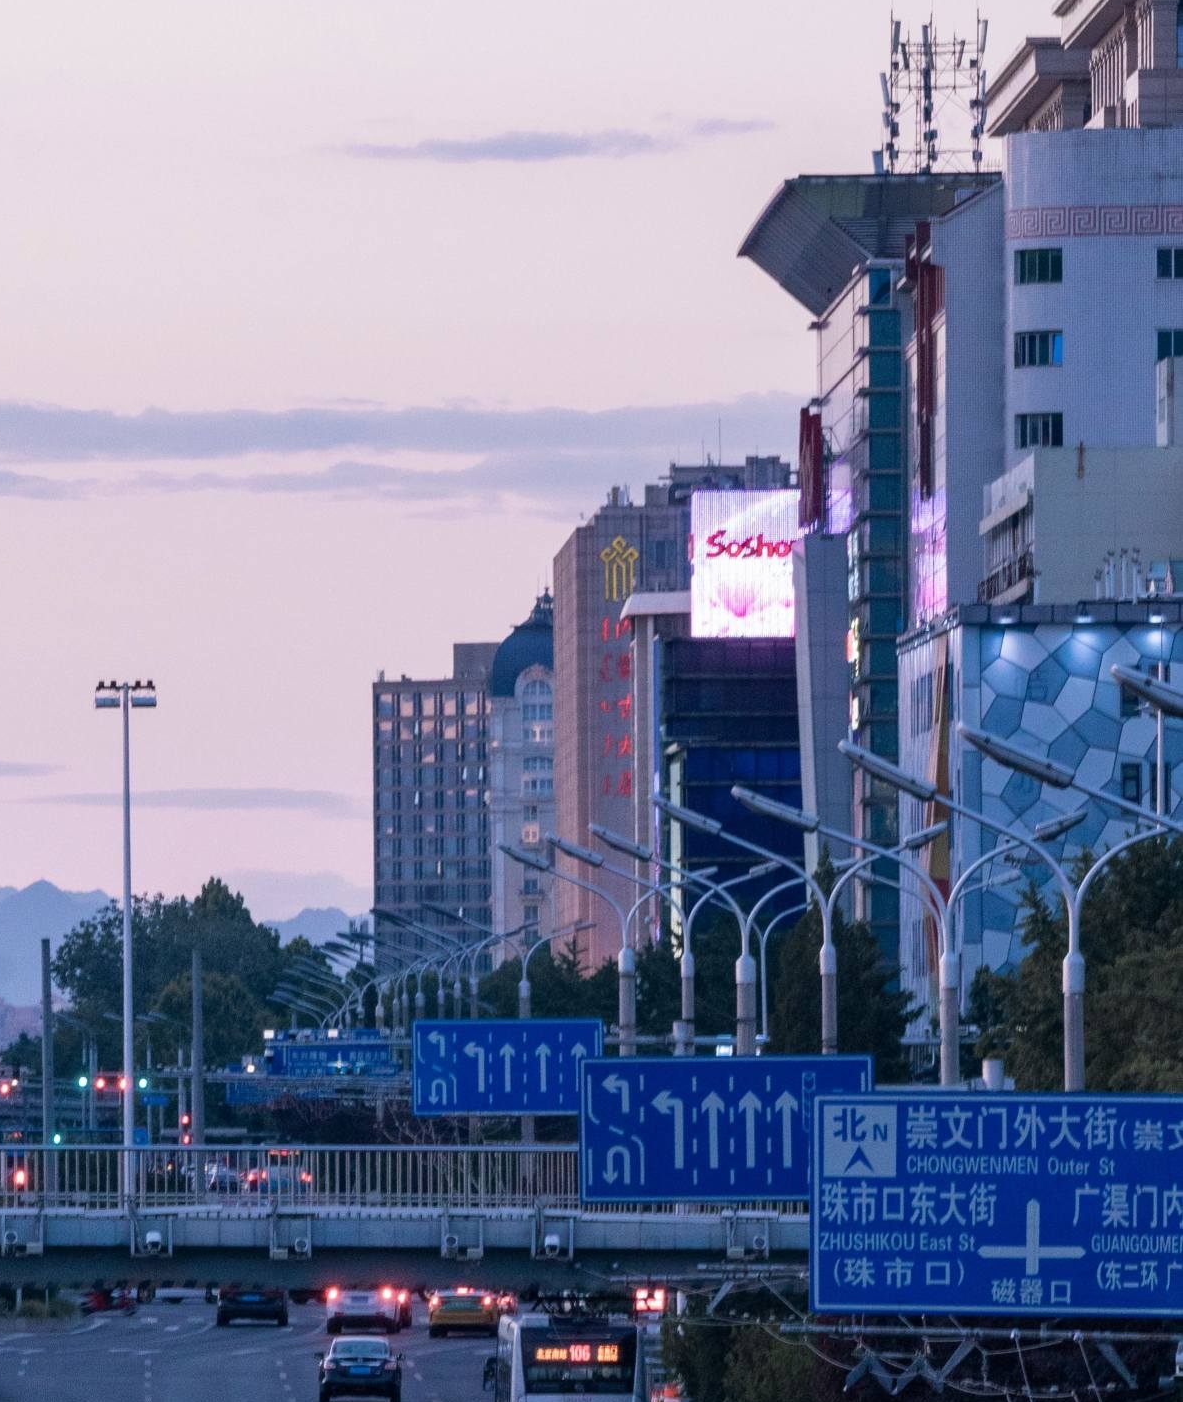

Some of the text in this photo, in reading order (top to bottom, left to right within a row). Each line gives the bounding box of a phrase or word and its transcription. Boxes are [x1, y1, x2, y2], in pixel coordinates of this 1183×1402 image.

[706, 530, 796, 558] Sosho
[833, 1108, 888, 1142] 北 N
[906, 1154, 1116, 1176] CHONGWENMEN Outer St
[821, 1181, 997, 1227] 珠市口东大街
[1072, 1182, 1183, 1229] 广渠门内
[819, 1232, 976, 1252] ZHUSHIKOU East St
[991, 1278, 1071, 1305] 磁器口
[570, 1345, 591, 1362] 106
